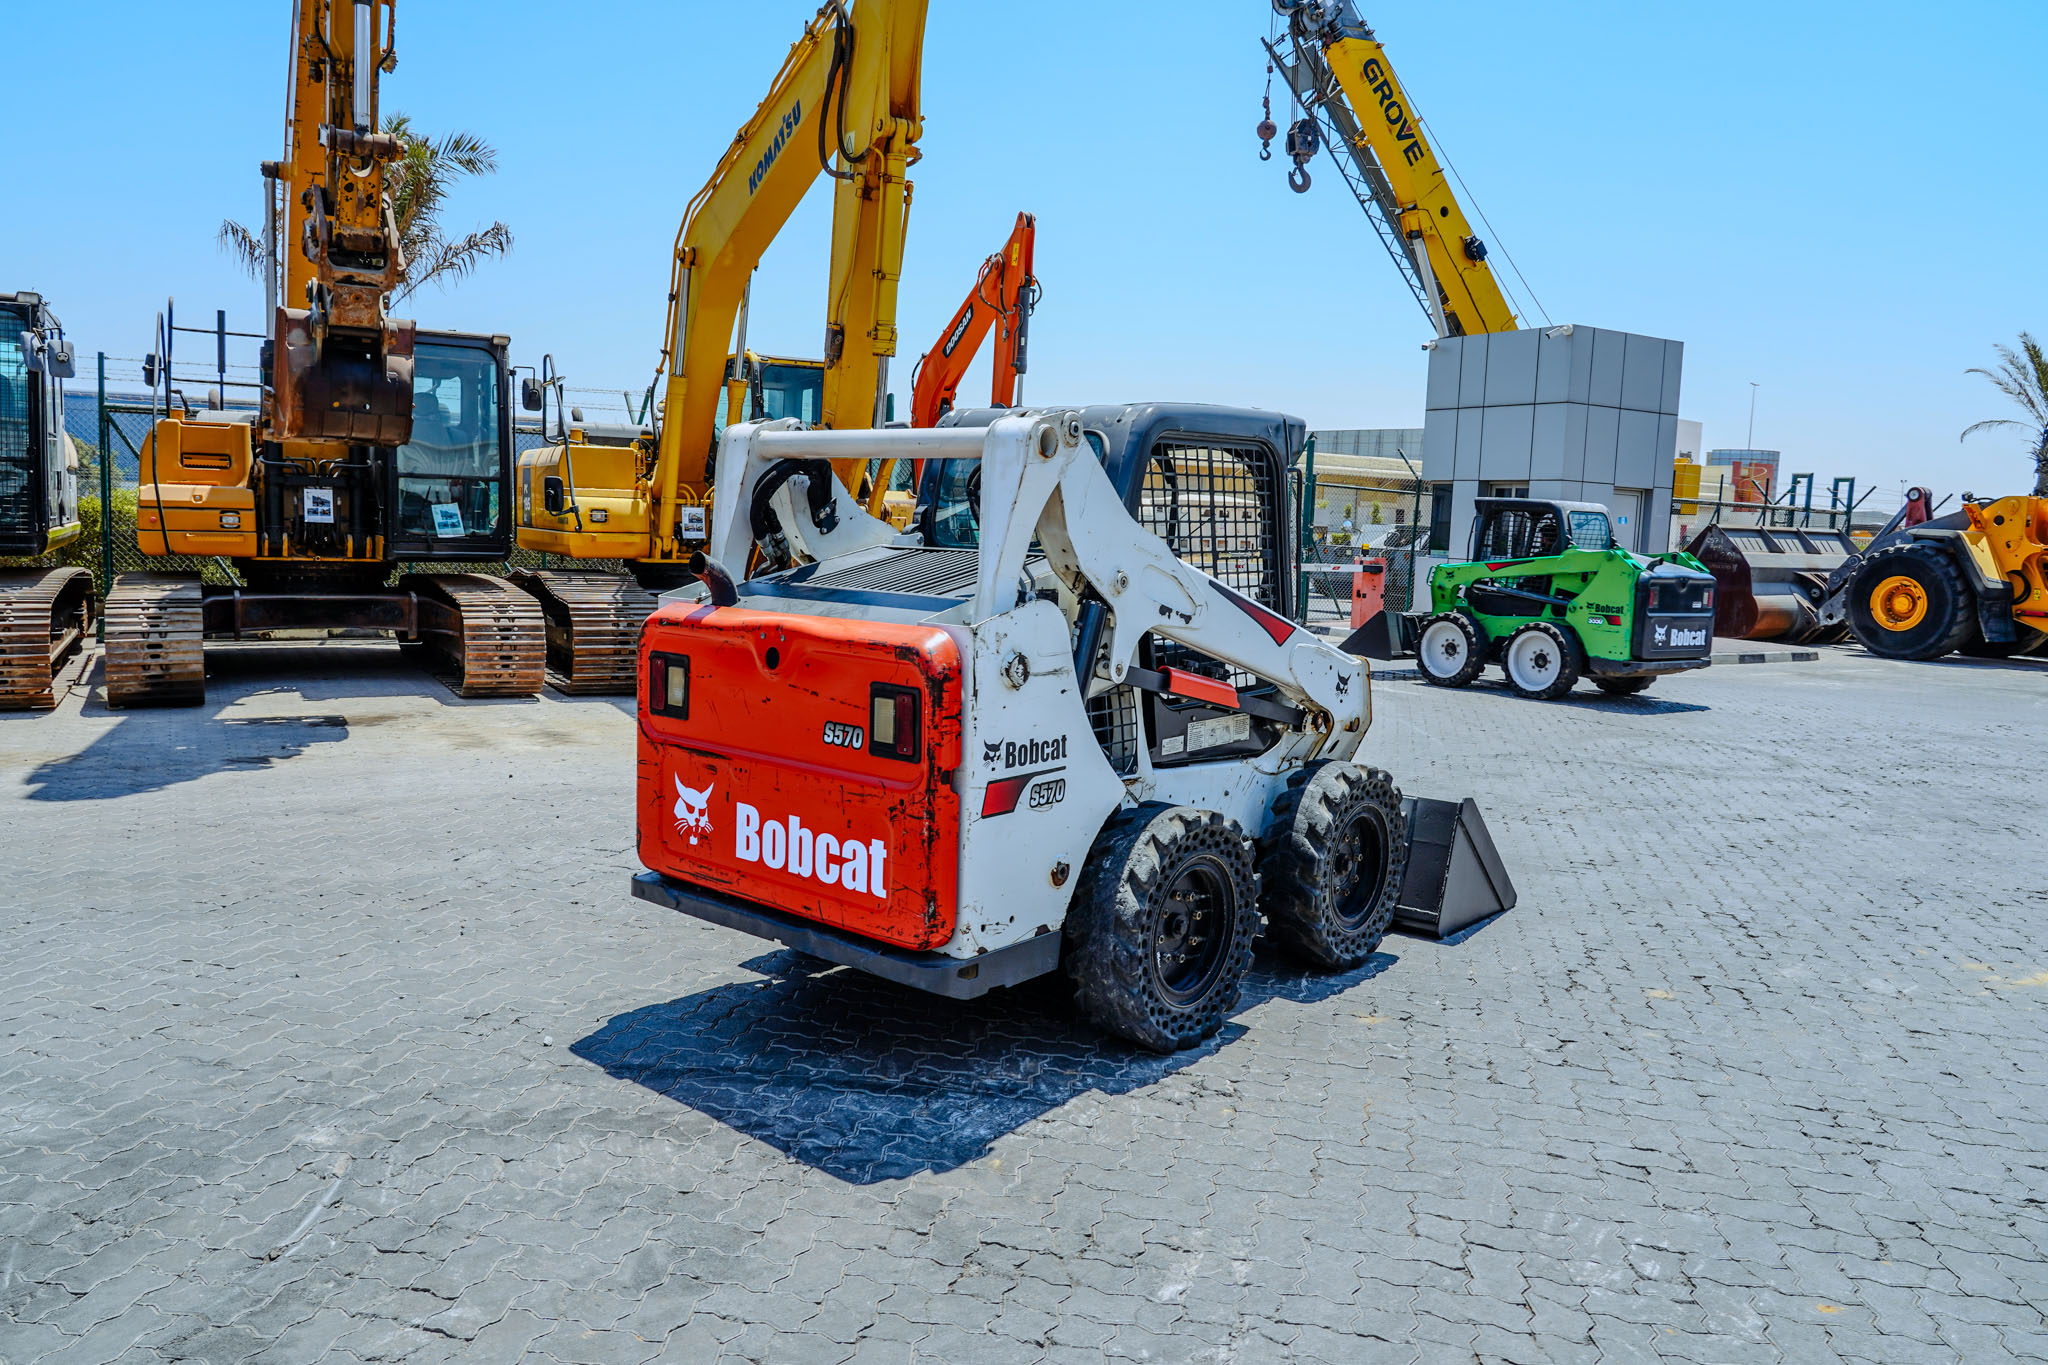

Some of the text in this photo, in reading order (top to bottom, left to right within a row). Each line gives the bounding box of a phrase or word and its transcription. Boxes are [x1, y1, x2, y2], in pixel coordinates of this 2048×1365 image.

[1363, 58, 1425, 167] GROVE
[748, 98, 801, 196] KOMATSU
[946, 308, 972, 355] DOOSAN
[1595, 603, 1624, 614] Bobcat
[1670, 628, 1707, 646] Bobcat
[823, 720, 864, 750] S570
[1005, 734, 1067, 768] Bobcat
[1029, 778, 1066, 808] S570
[736, 802, 887, 898] Bobcat
